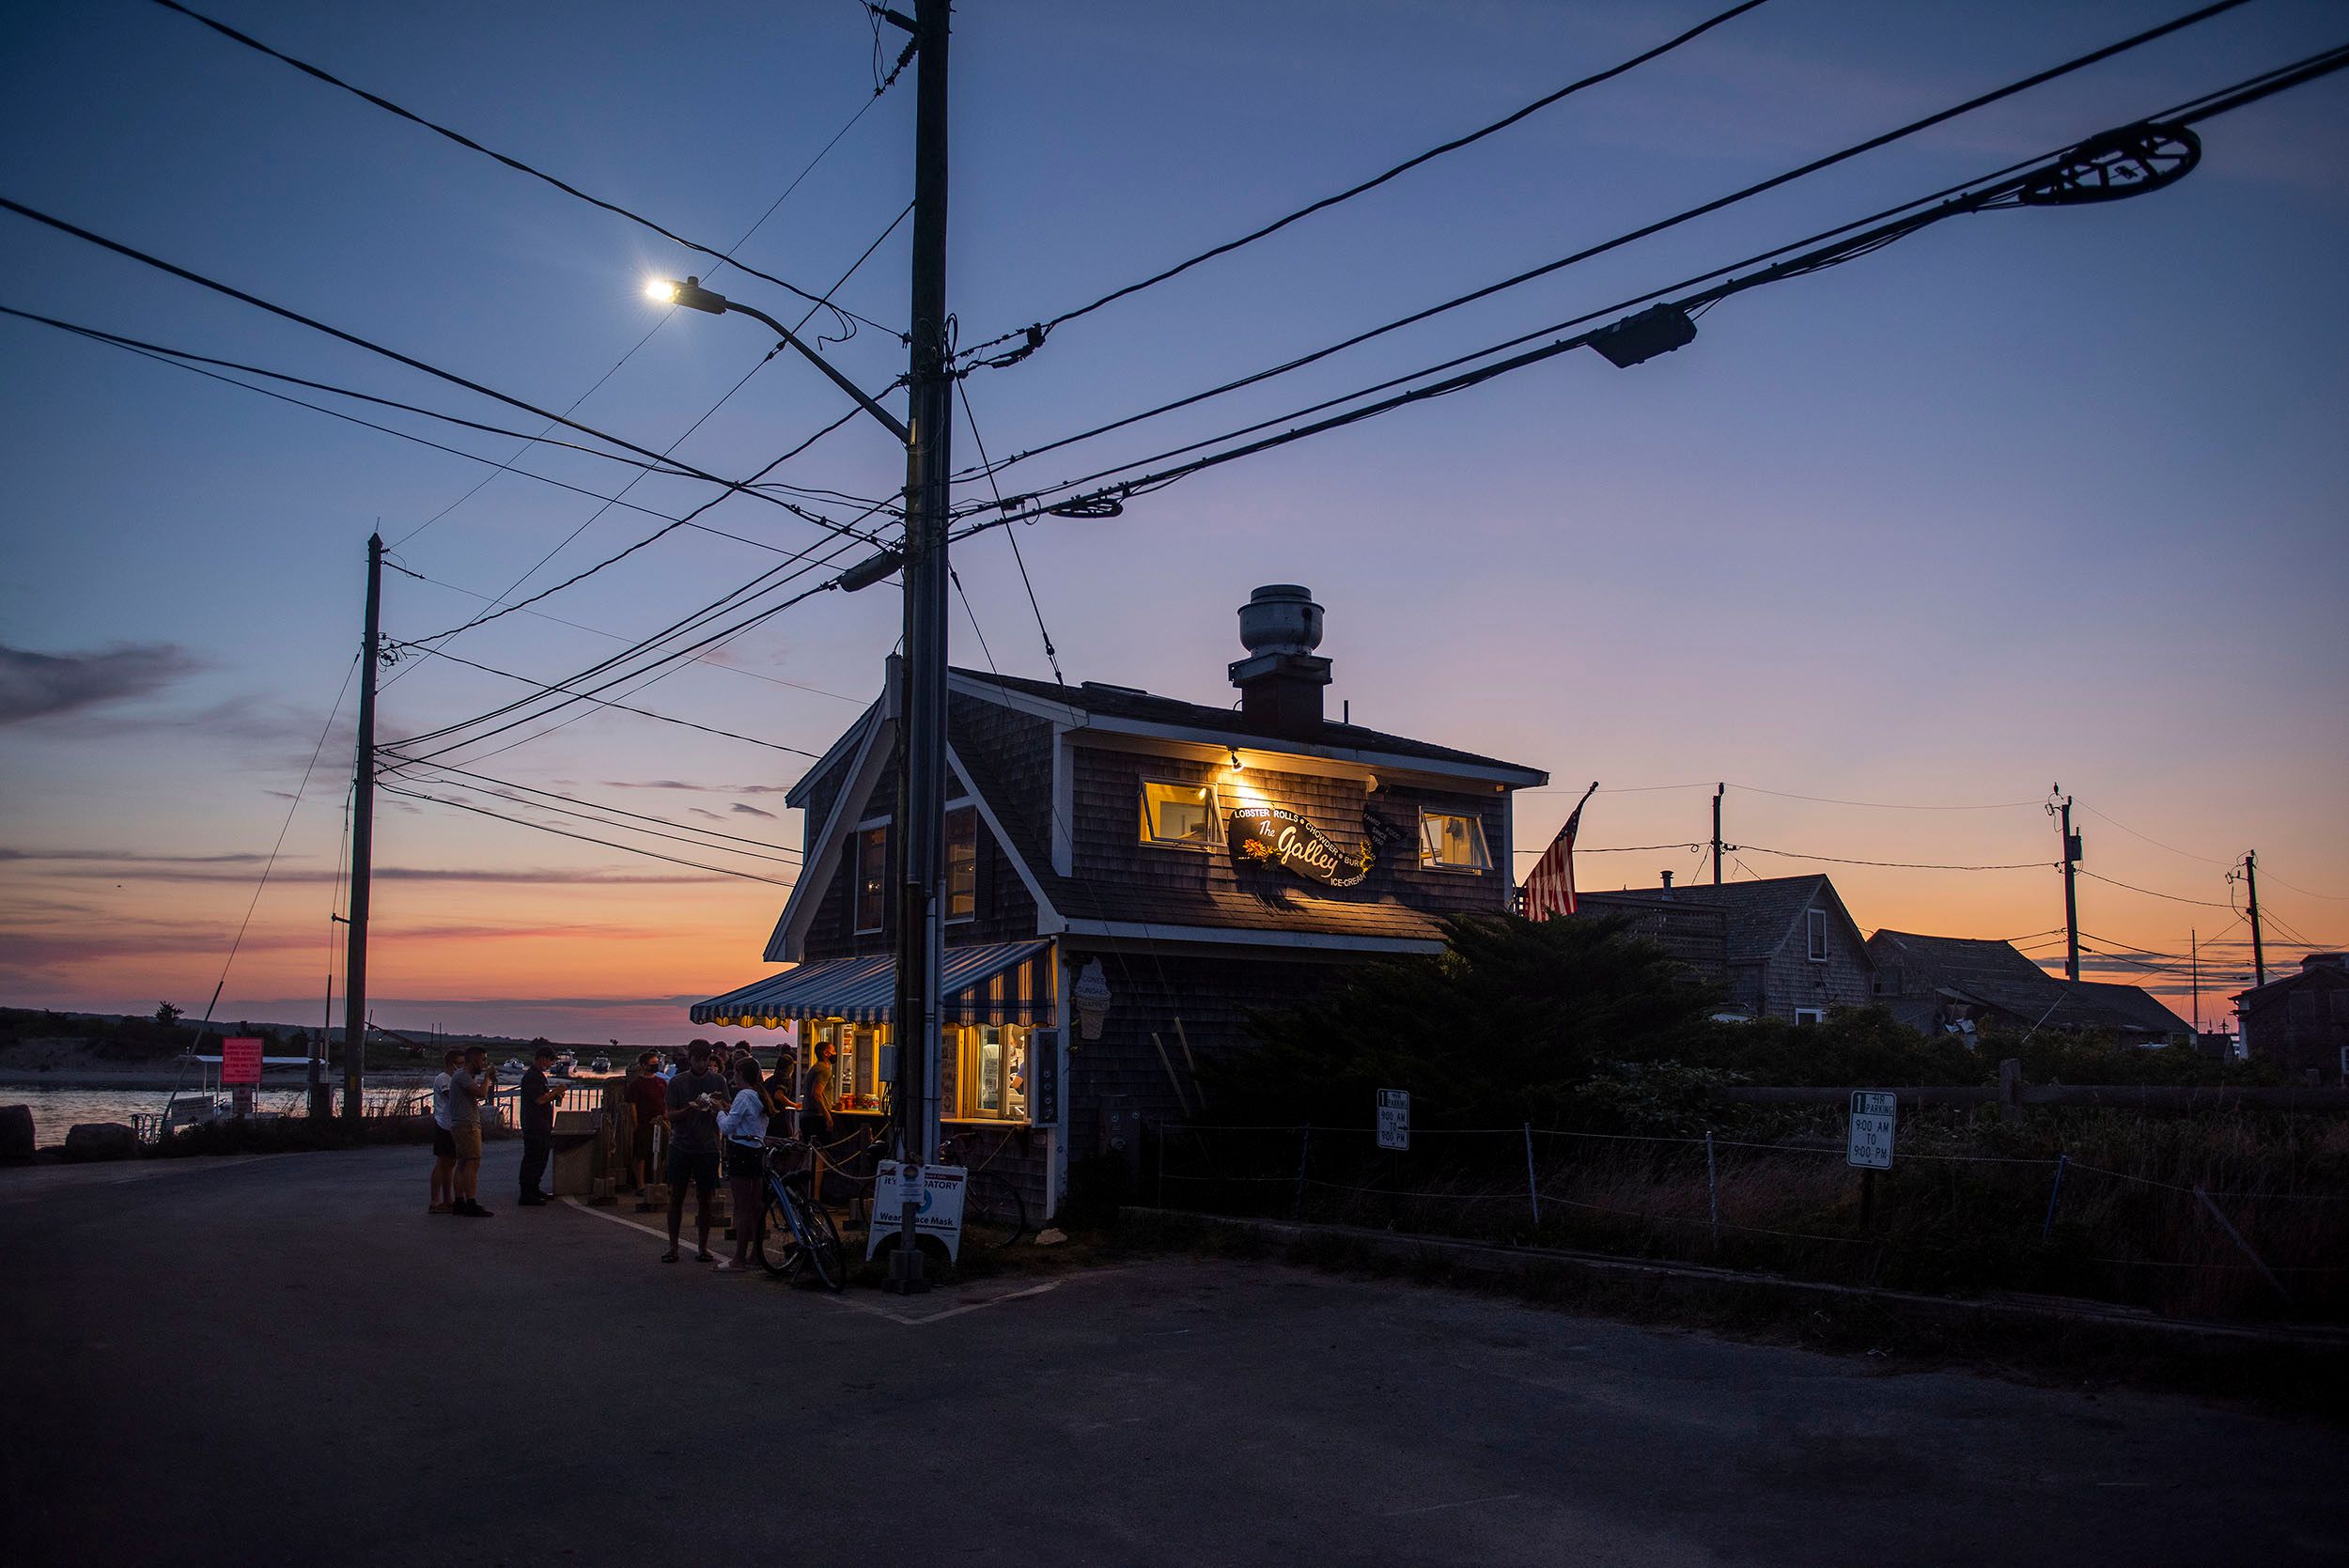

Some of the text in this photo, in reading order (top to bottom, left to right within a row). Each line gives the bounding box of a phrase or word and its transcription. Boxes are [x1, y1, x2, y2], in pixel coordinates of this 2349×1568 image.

[1235, 809, 1270, 818] LOBSTER
[1273, 810, 1299, 823] ROLLS
[1305, 822, 1339, 856] CHOWDER
[1260, 820, 1275, 837] The
[1278, 826, 1338, 877] Galley
[1330, 872, 1367, 887] ICE-CREAM
[1865, 1103, 1893, 1114] PARKING
[1877, 1122, 1889, 1133] AM
[1867, 1133, 1876, 1145] TO
[1875, 1147, 1888, 1159] PM
[880, 1212, 954, 1226] Wear ace Mask
